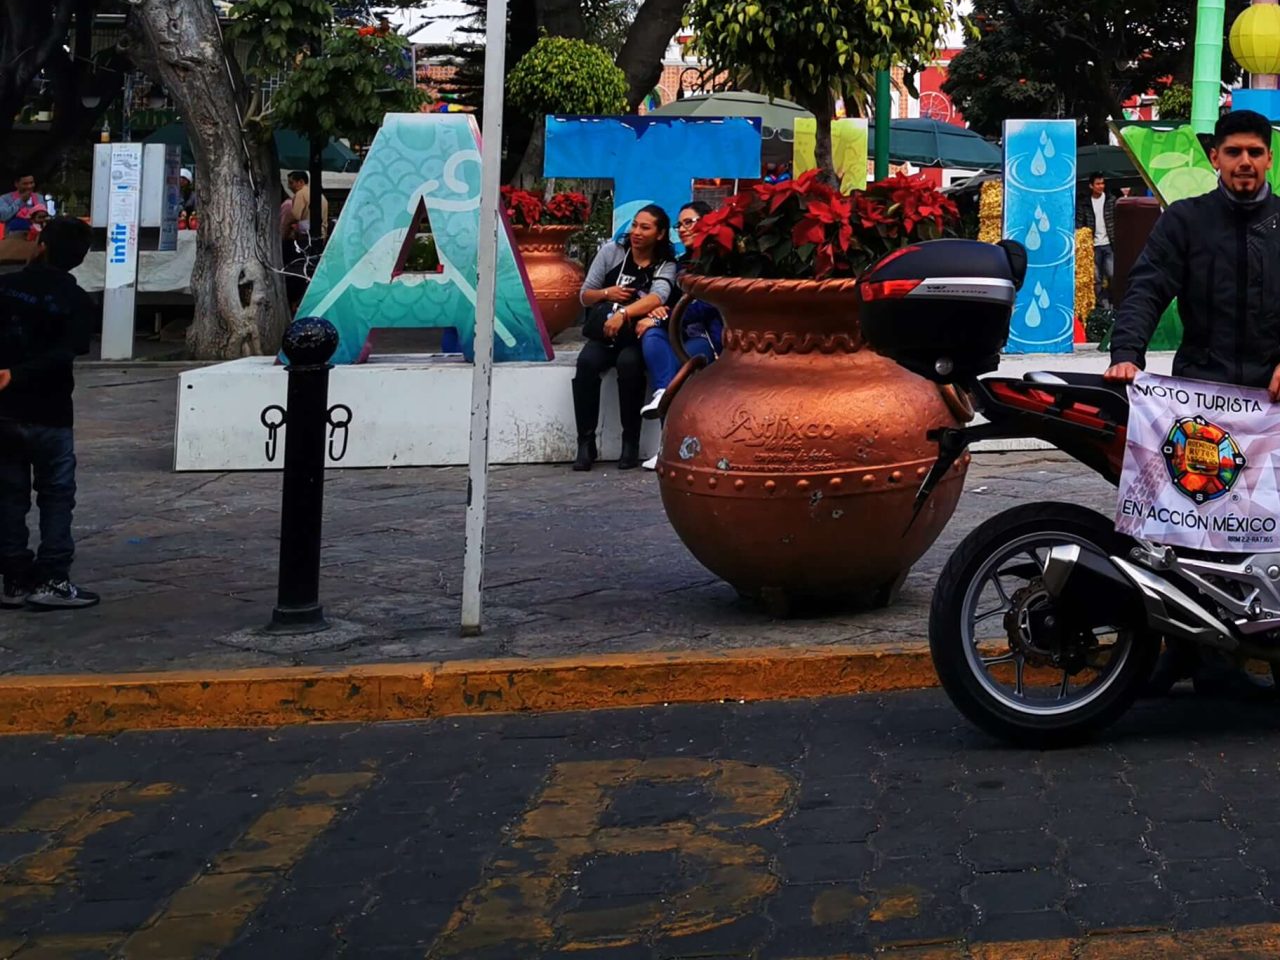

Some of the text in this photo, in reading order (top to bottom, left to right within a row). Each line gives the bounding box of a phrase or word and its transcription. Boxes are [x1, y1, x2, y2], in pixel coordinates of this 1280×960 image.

[1135, 384, 1263, 413] MOTO TURISTA
[720, 413, 837, 445] Atlixco
[1122, 499, 1276, 532] EN ACCIÓN MÉXICO
